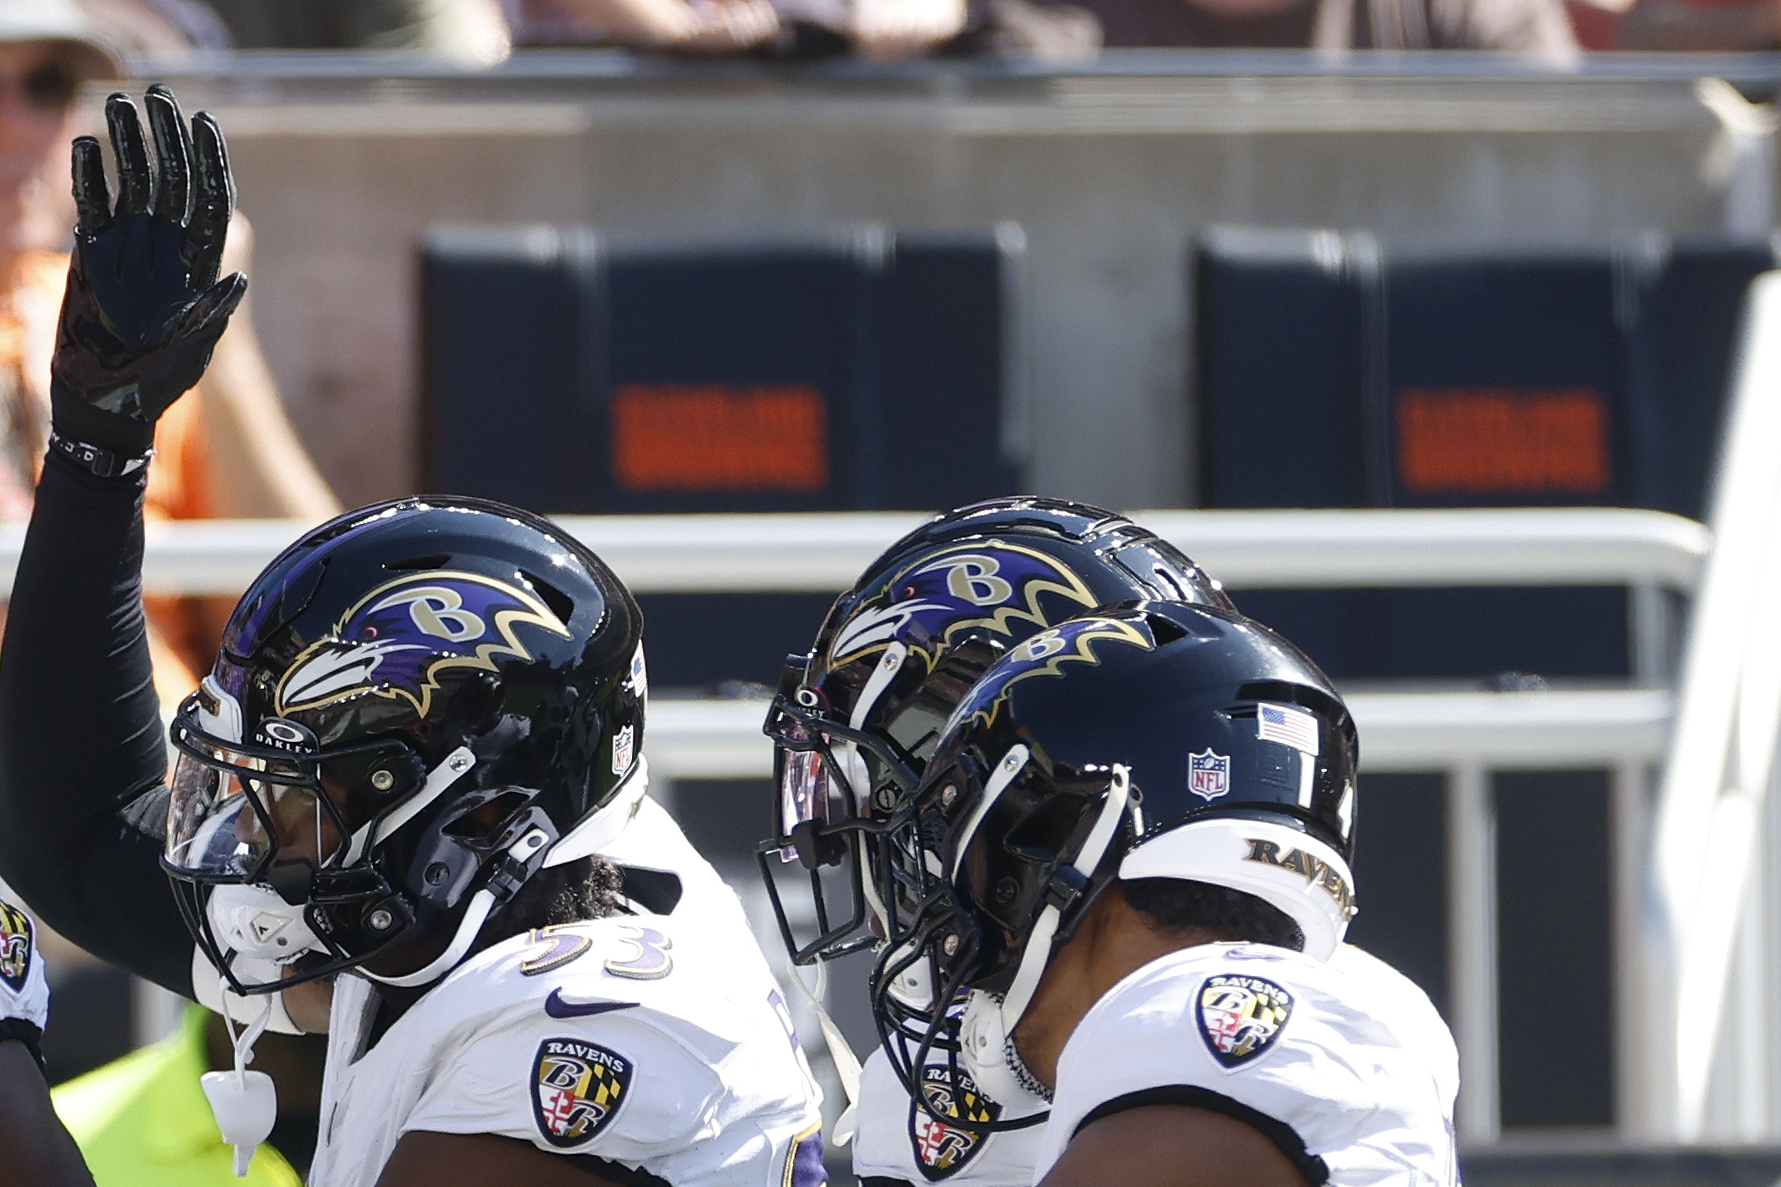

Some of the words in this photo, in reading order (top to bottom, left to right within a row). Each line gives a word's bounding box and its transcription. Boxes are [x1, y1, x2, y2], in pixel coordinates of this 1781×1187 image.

[912, 554, 1013, 607] B
[366, 586, 486, 643] B
[1010, 629, 1067, 663] B
[1193, 771, 1225, 792] NFL
[520, 923, 674, 981] 53
[1209, 976, 1290, 1006] RAVENS
[547, 1041, 625, 1074] RAVENS
